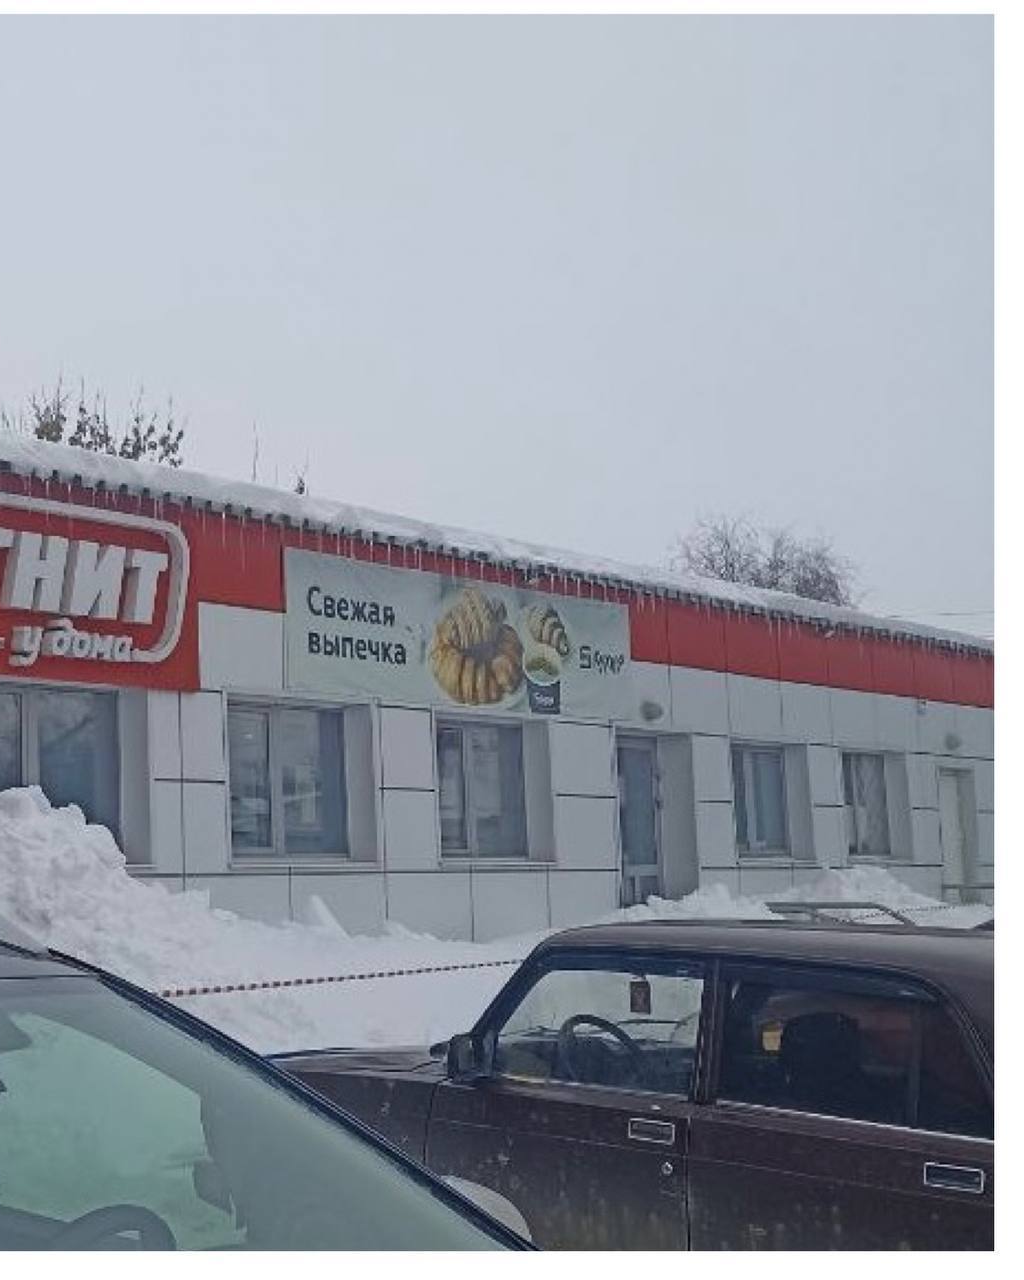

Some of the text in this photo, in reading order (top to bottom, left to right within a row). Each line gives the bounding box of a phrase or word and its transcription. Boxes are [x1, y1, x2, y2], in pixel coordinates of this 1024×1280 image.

[307, 586, 395, 626] Свежая
[42, 618, 133, 662] дома
[308, 631, 407, 666] выпечка
